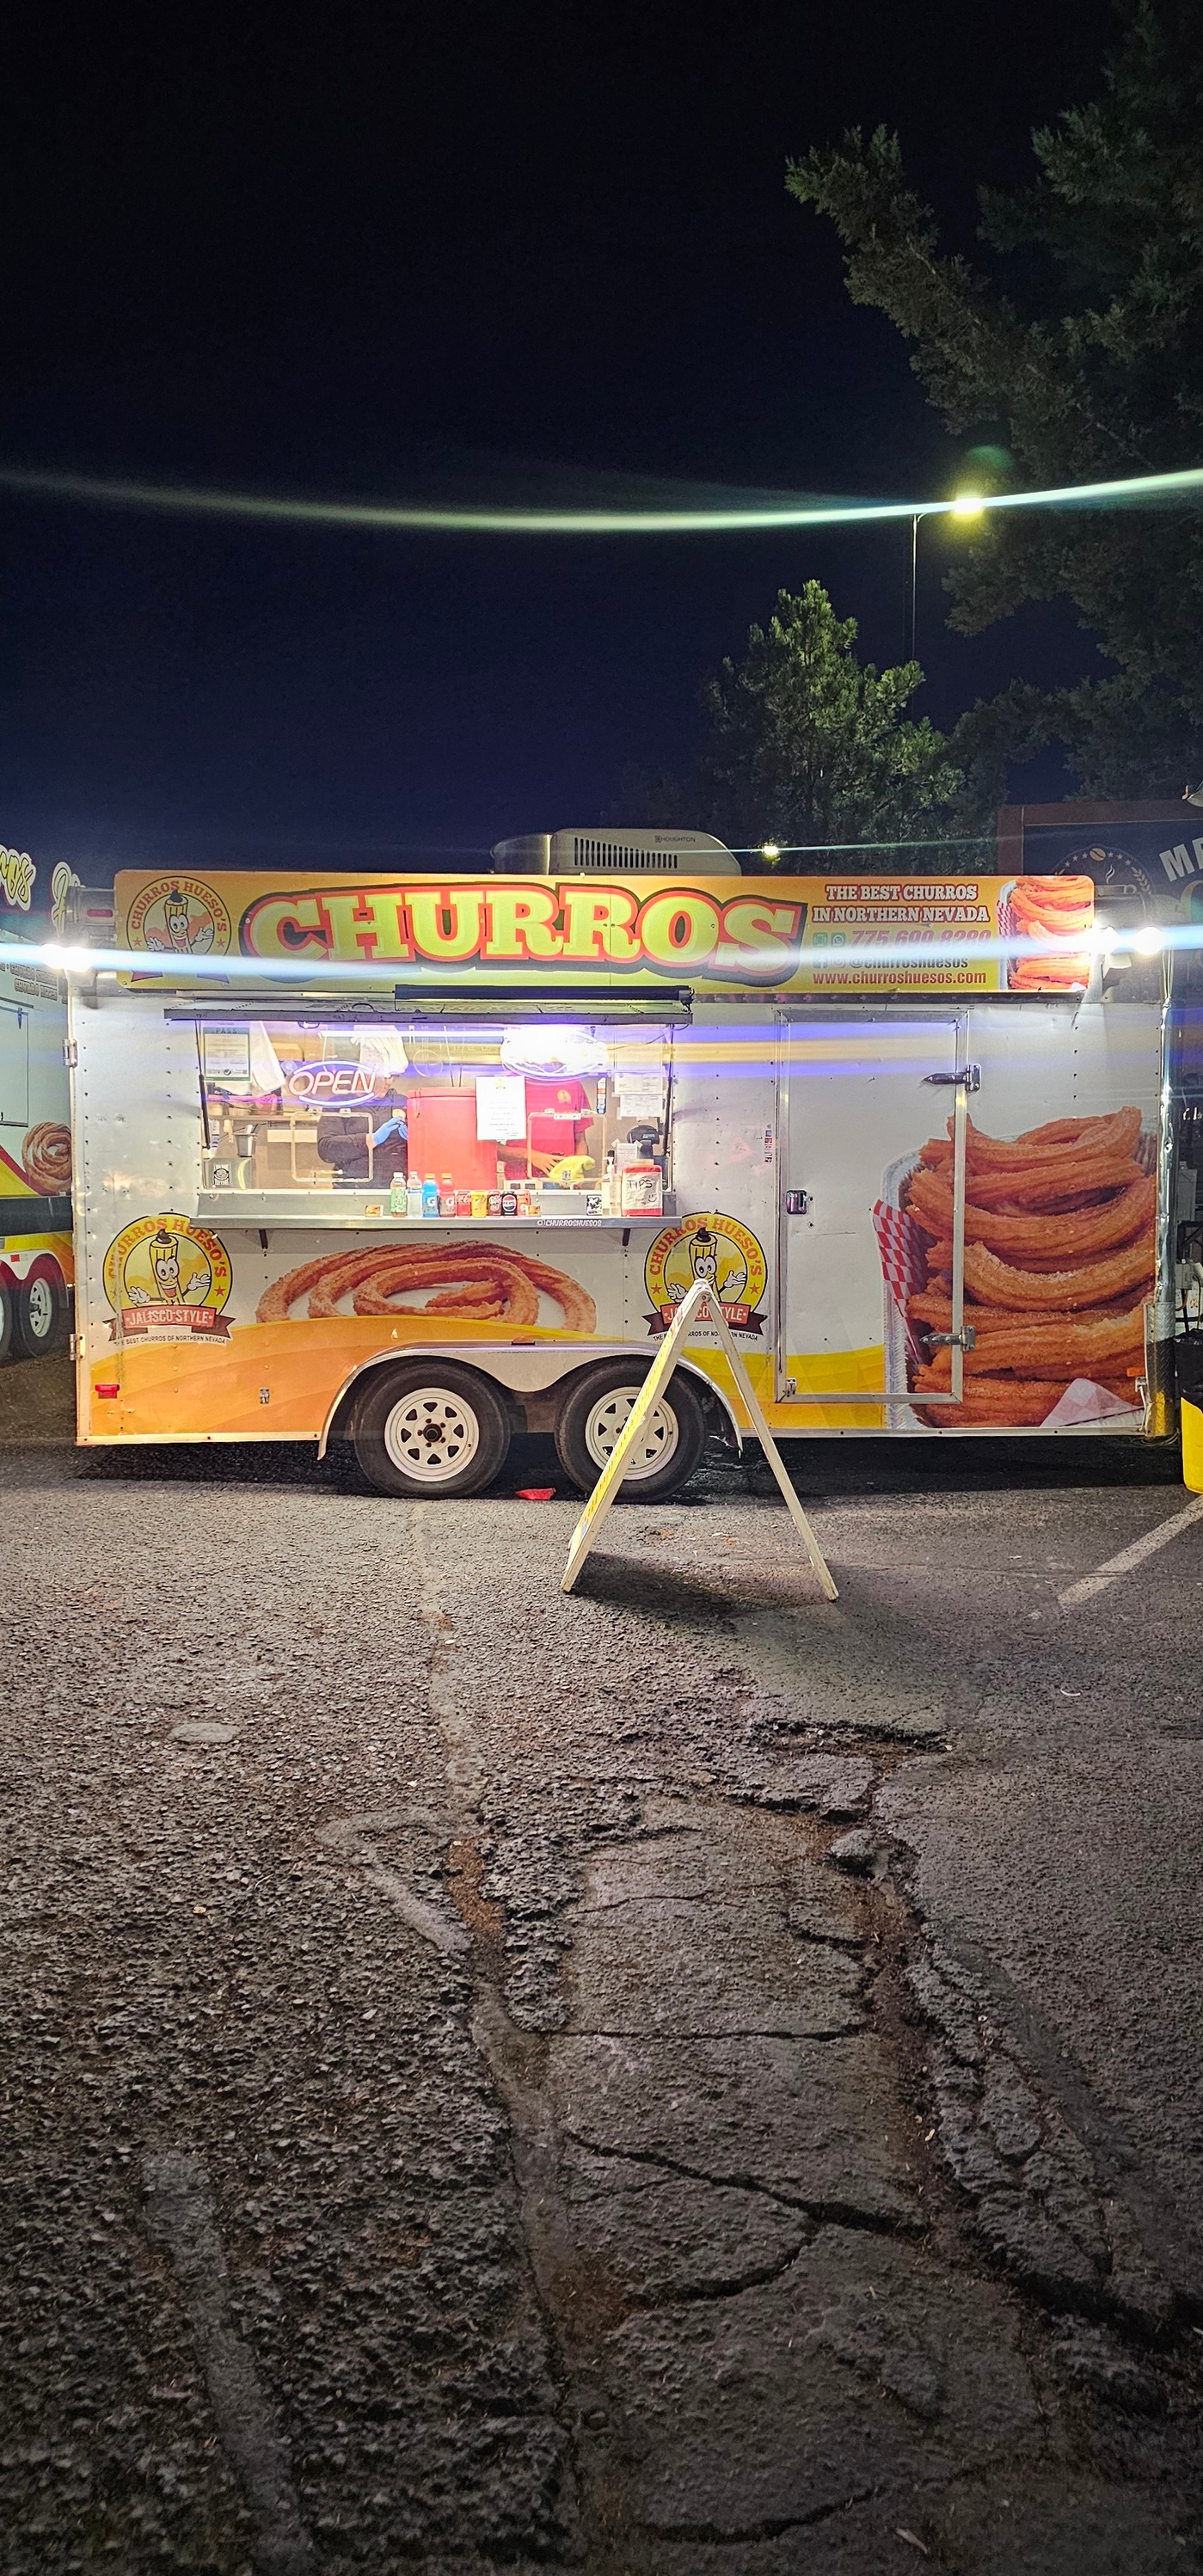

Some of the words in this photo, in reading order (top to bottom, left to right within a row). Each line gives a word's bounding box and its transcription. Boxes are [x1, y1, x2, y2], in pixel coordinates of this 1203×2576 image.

[826, 886, 857, 900] THE
[861, 886, 899, 900] BEST
[904, 885, 977, 900] CHURROS
[131, 880, 180, 929] CHURROS
[183, 880, 227, 932] HUESO'S
[813, 907, 830, 922] IN
[834, 907, 919, 922] NORTHERN
[923, 907, 990, 922] NEVADA
[244, 886, 805, 980] CHURROS
[813, 971, 987, 984] www.churroshuesos.com
[288, 1070, 377, 1096] OPEN
[627, 1179, 653, 1190] TIPS
[649, 1217, 708, 1275] CHURROS
[712, 1217, 762, 1276] HUESO'S
